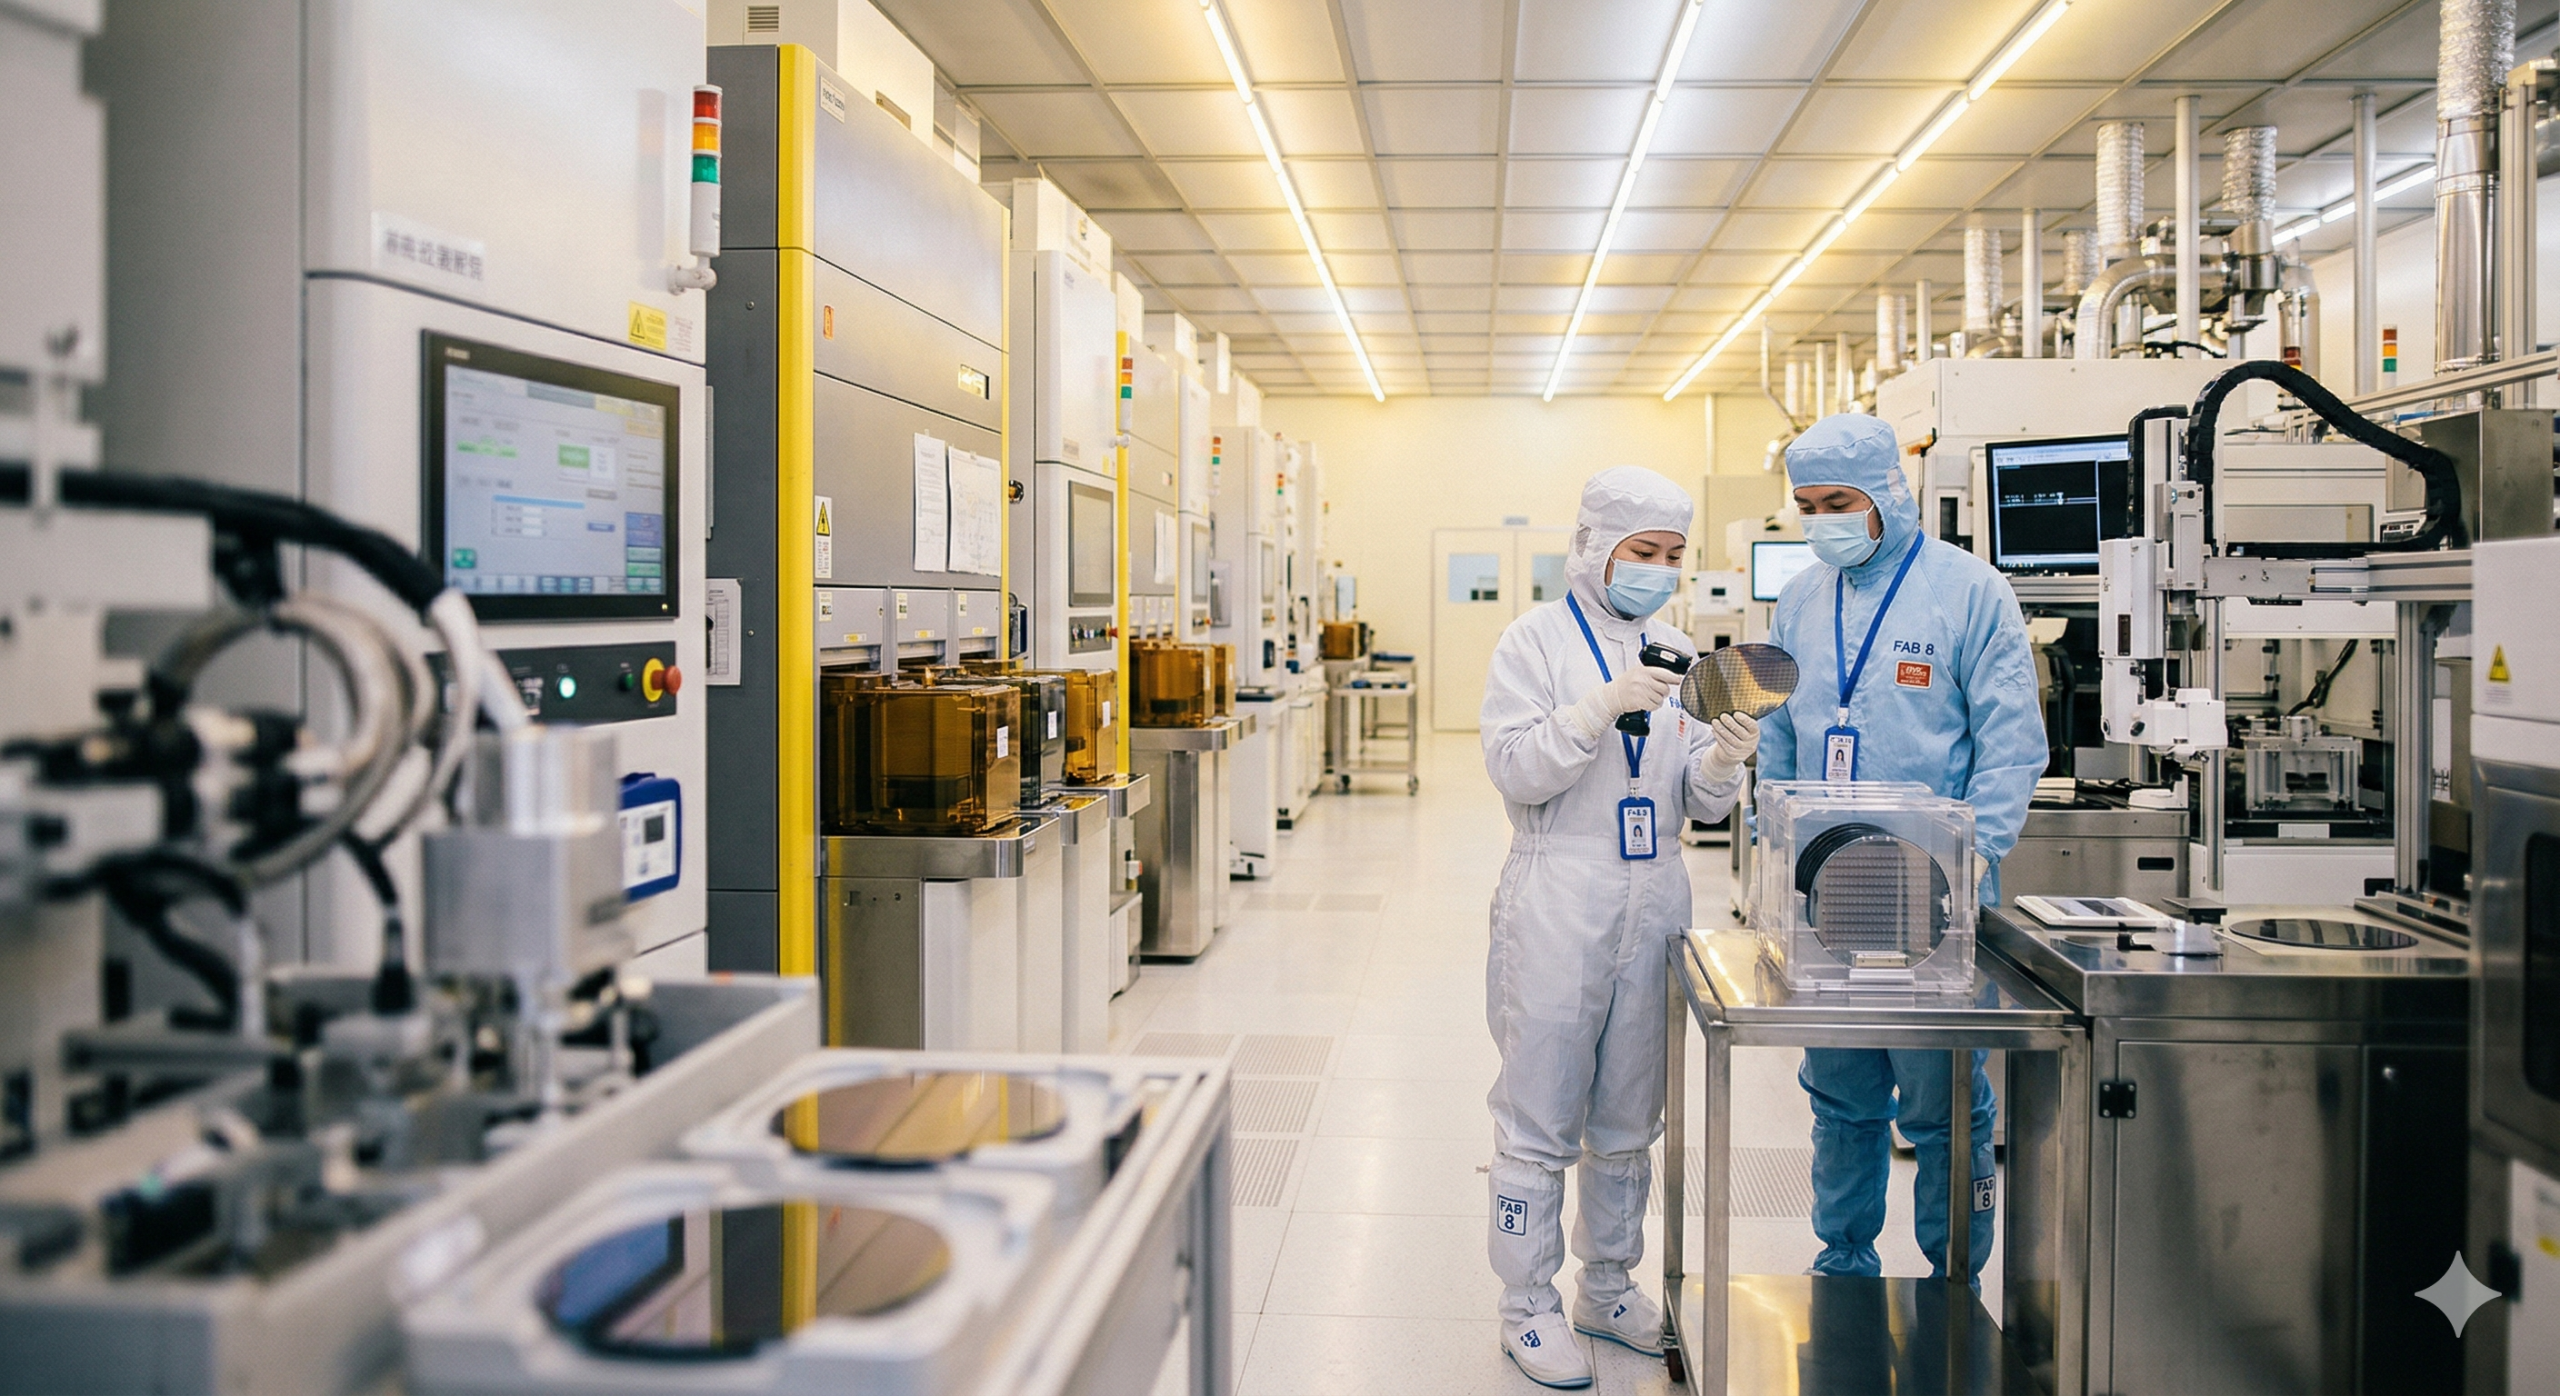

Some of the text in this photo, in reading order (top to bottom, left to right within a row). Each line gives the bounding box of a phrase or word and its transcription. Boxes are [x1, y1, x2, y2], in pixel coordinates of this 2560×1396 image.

[1893, 640, 1934, 656] FAB 8
[1500, 1200, 1522, 1215] FAB
[1982, 1192, 1991, 1208] 8
[1504, 1214, 1515, 1230] 8
